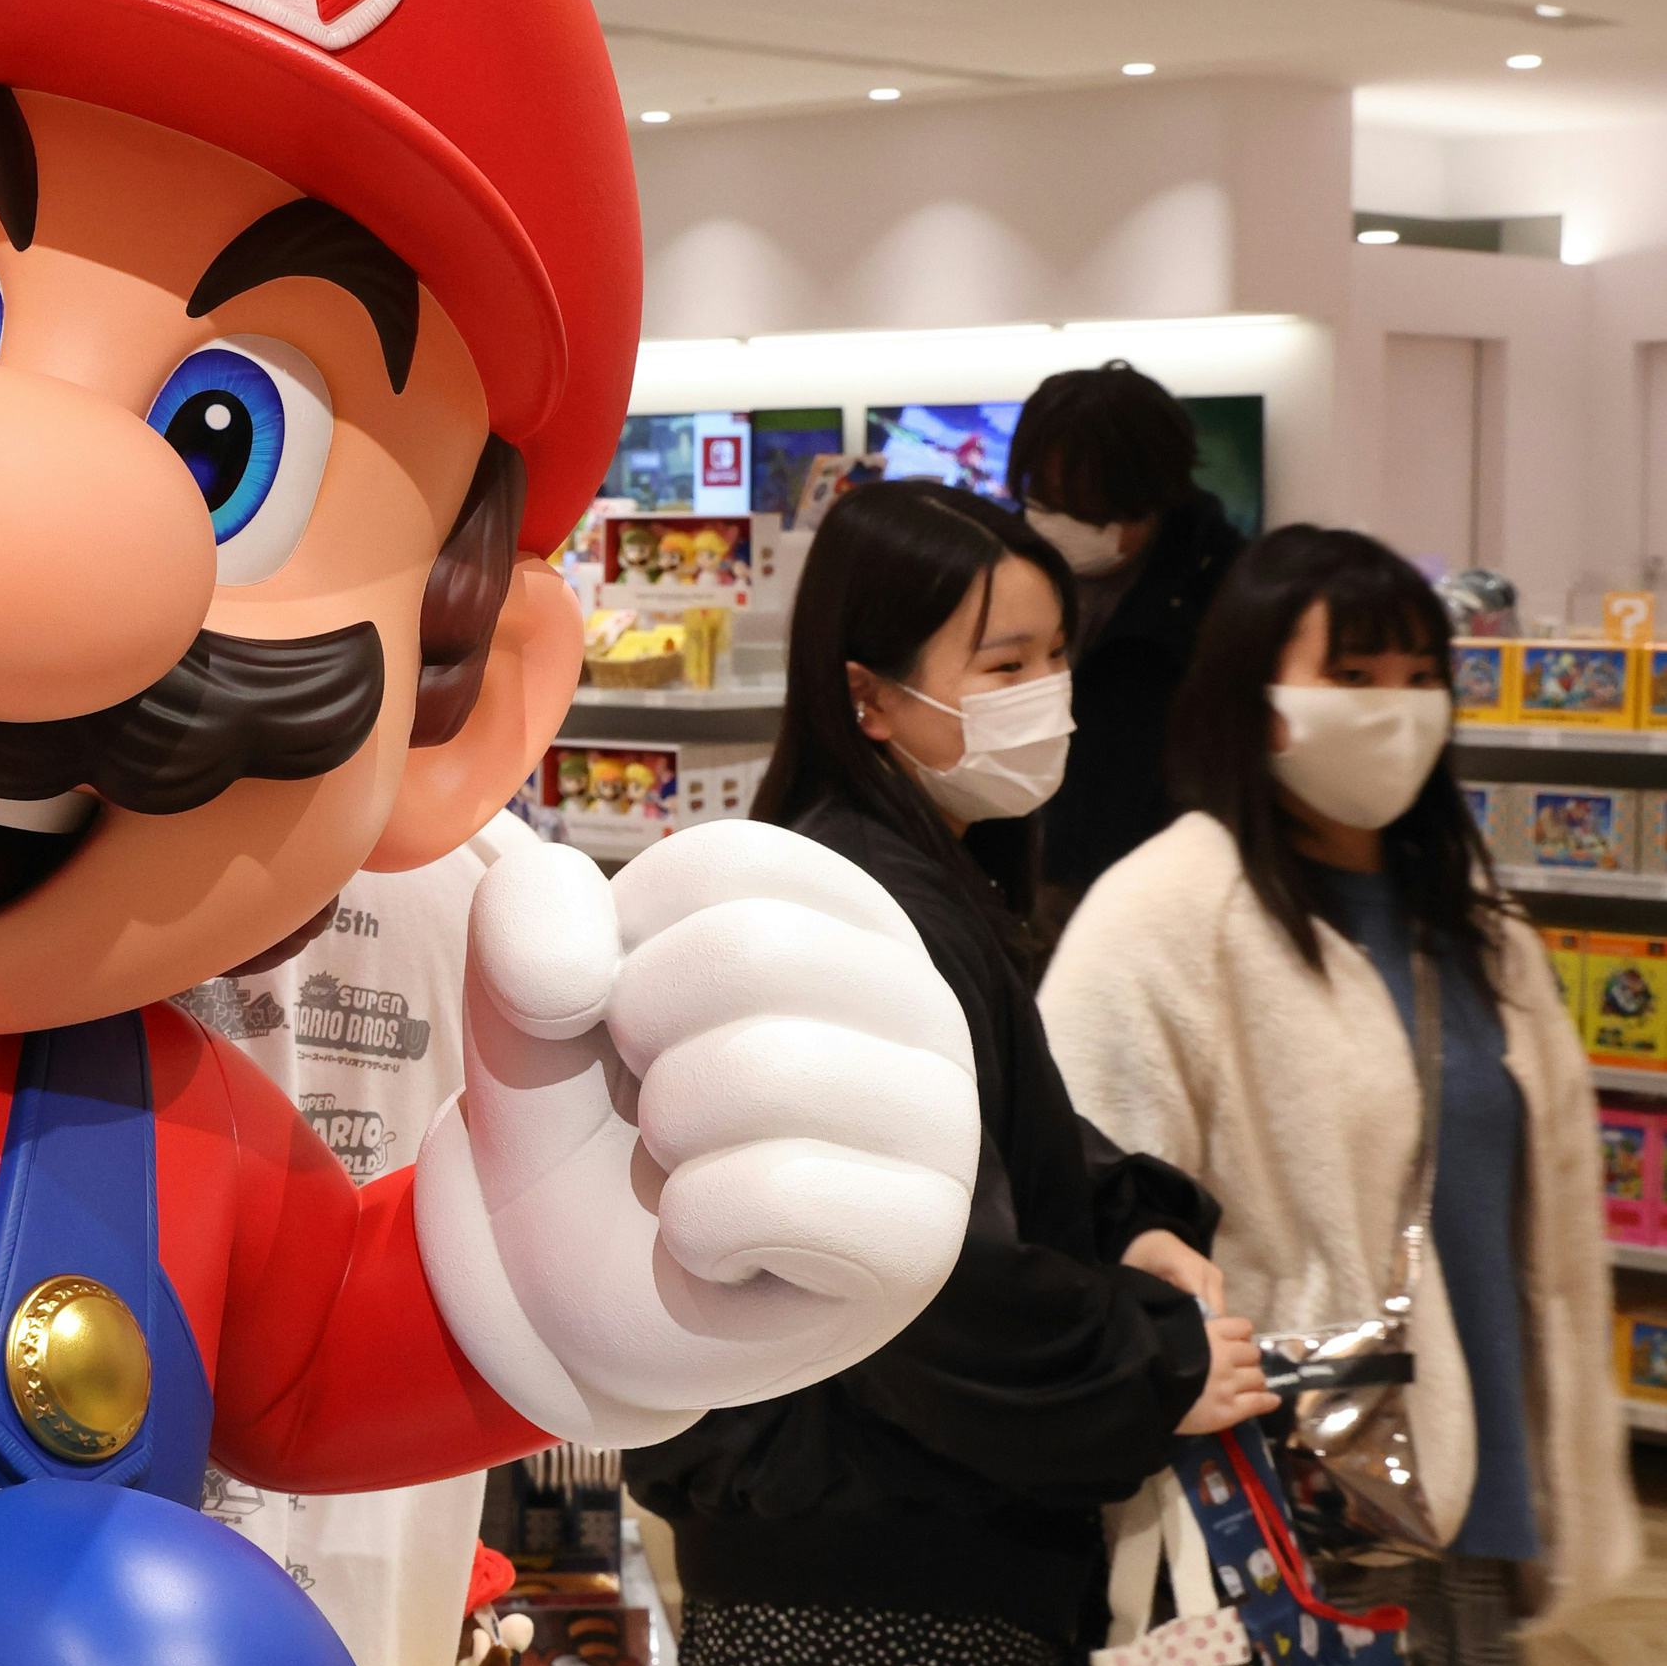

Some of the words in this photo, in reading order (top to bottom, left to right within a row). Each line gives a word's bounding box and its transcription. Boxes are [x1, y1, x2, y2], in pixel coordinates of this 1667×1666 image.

[325, 906, 379, 938] 5th
[338, 987, 403, 1015] SUPER
[346, 1013, 403, 1051] BROS.
[298, 1095, 335, 1111] UPER
[313, 1116, 384, 1148] ARIO
